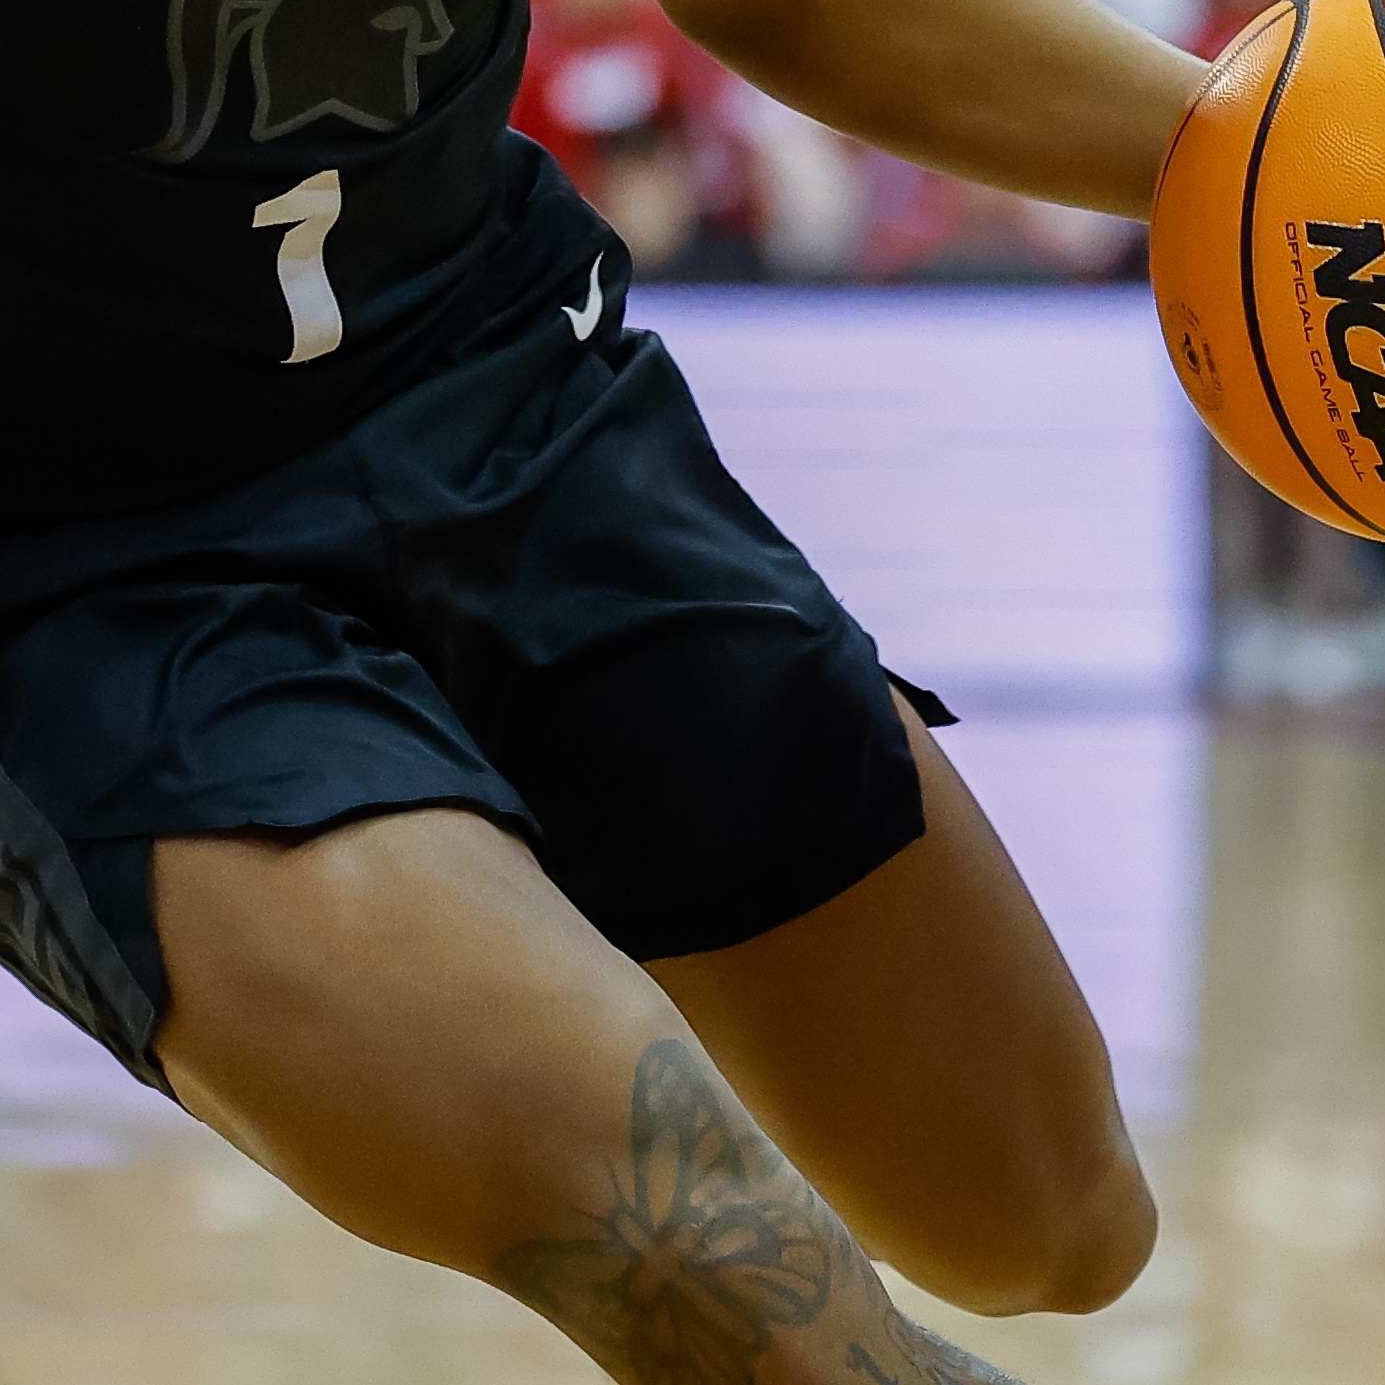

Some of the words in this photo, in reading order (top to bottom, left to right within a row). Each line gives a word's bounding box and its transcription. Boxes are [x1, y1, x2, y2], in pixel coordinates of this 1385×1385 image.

[252, 169, 343, 363] 1
[1285, 222, 1314, 343] OFFICIAL
[1310, 349, 1342, 423] GAME
[1336, 428, 1365, 483] BALL
